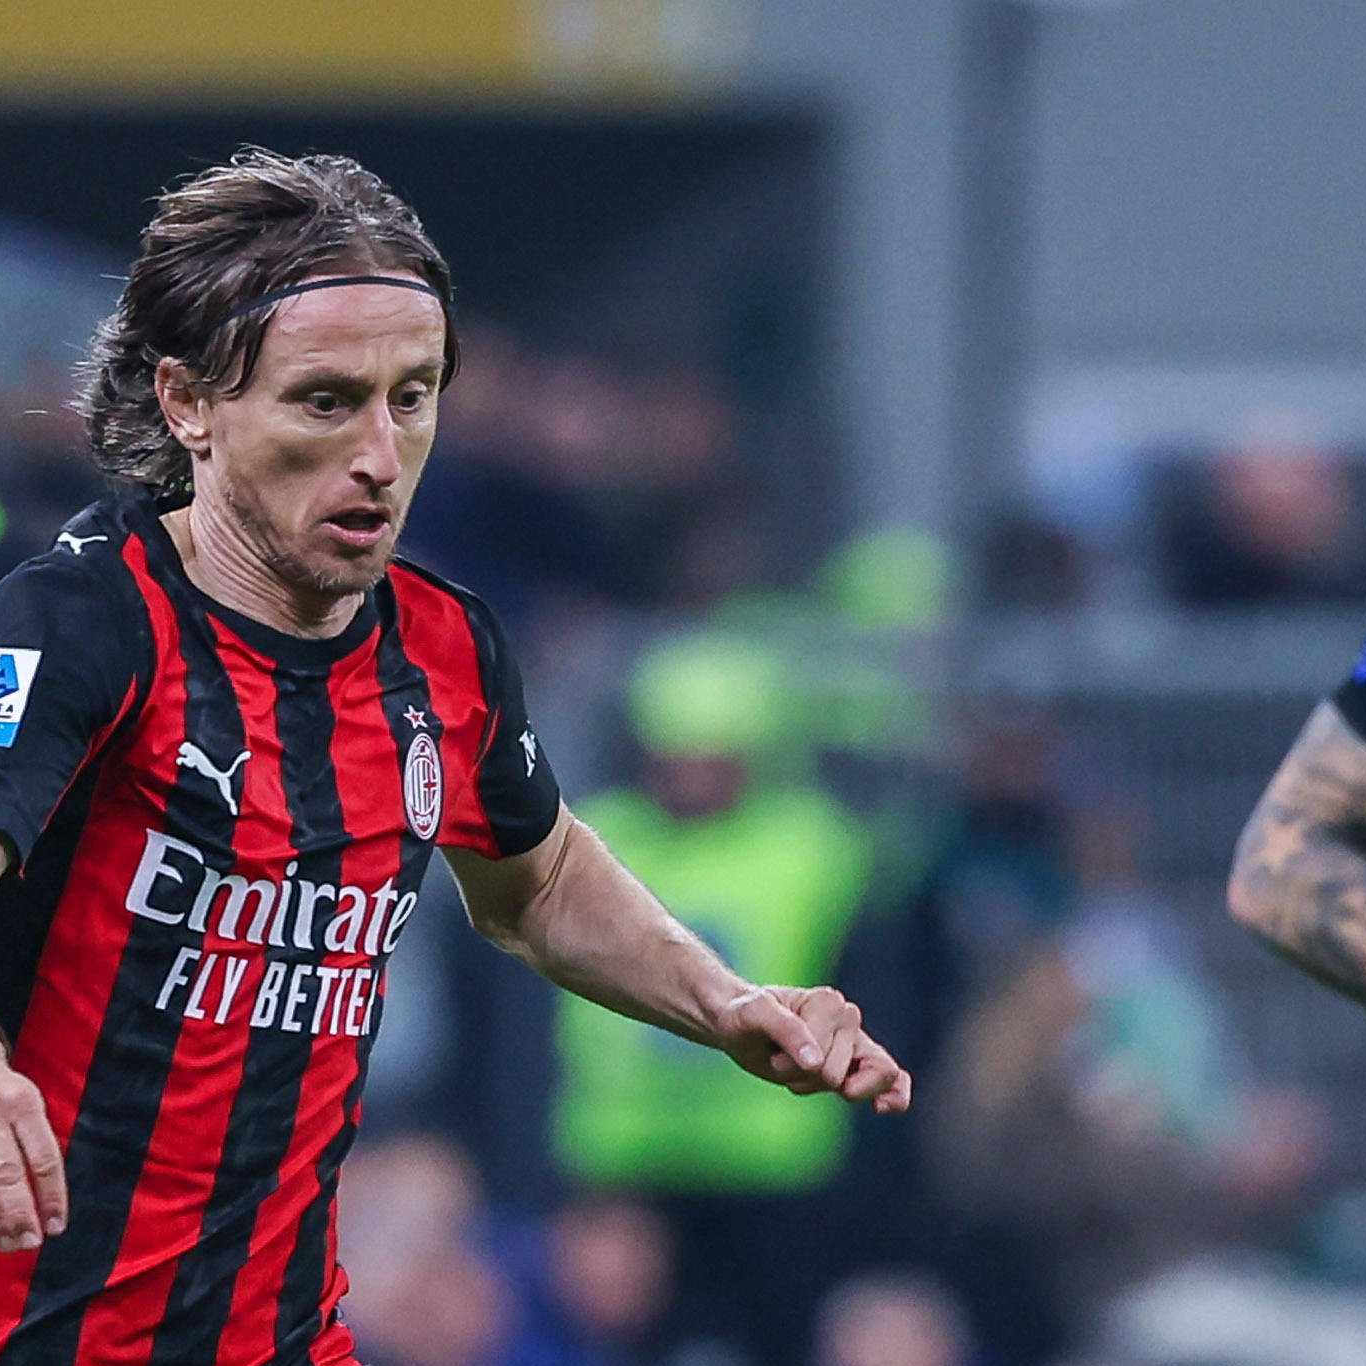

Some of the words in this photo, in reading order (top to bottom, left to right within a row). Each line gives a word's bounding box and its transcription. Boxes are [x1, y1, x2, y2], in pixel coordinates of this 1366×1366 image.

[5, 704, 14, 713] A
[125, 828, 418, 956] Emirate
[155, 946, 248, 1025] FLY
